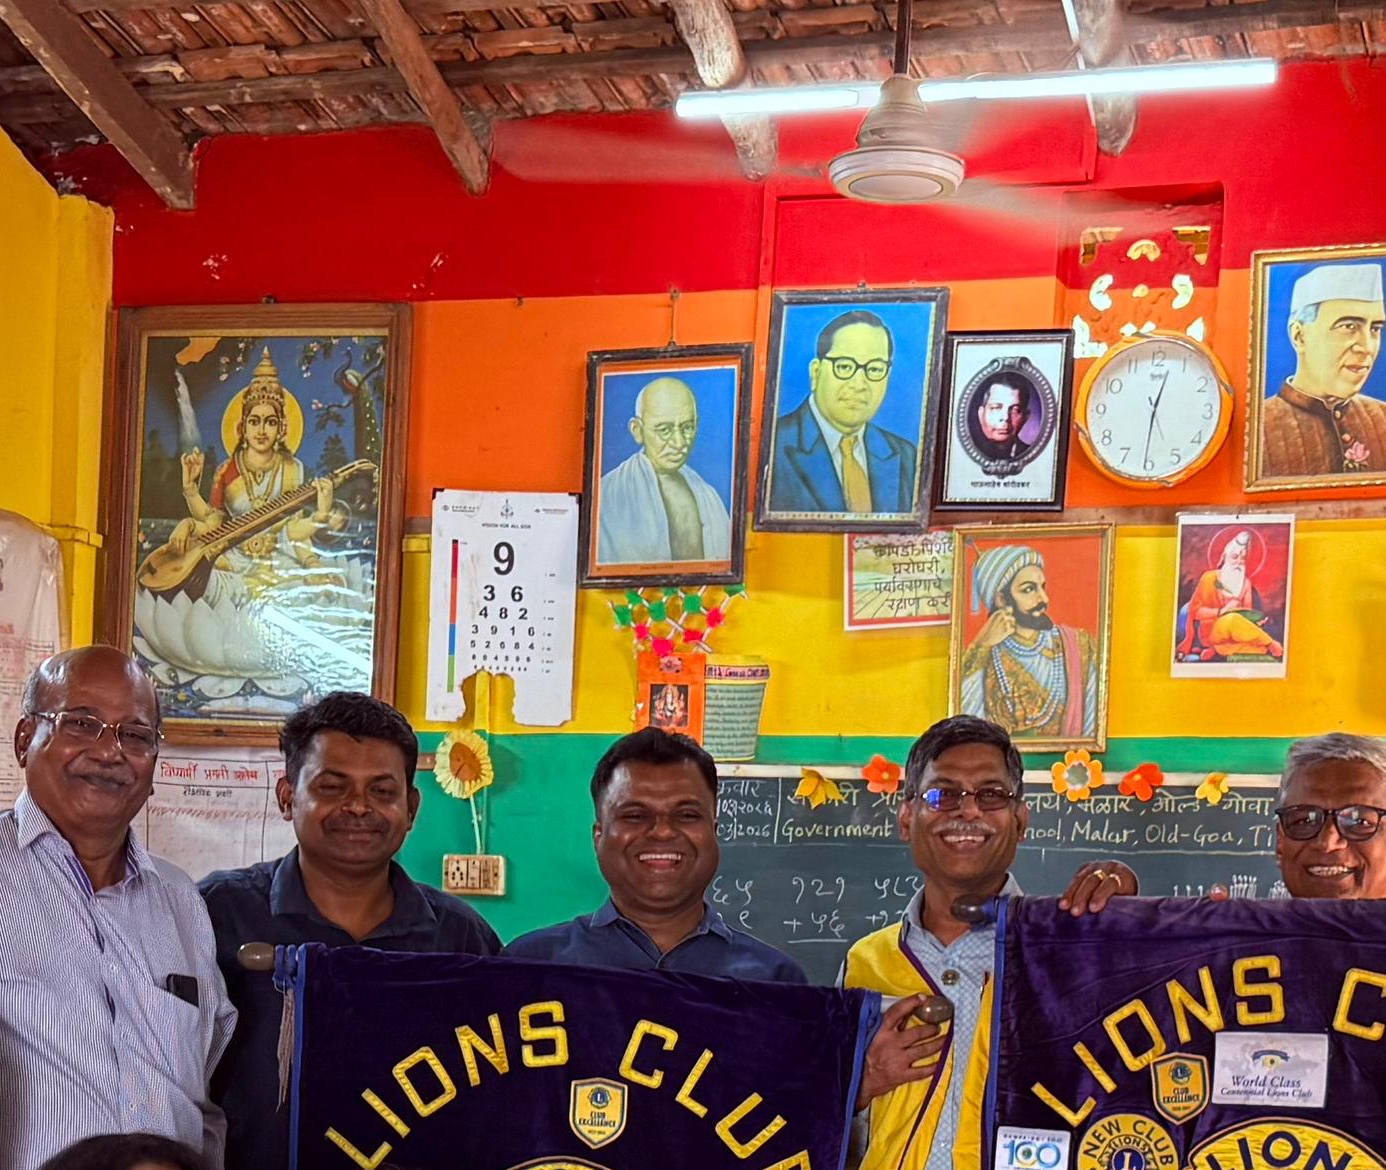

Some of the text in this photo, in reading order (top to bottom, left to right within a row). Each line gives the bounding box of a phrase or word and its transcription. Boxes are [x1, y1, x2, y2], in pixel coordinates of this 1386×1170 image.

[1151, 351, 1166, 367] 12
[1105, 378, 1123, 394] 10
[1196, 377, 1208, 393] 2
[1096, 404, 1107, 419] 9
[1202, 403, 1213, 420] 3
[1101, 429, 1112, 446] 8
[1190, 430, 1203, 444] 4
[1120, 447, 1131, 464] 7
[1170, 449, 1181, 465] 5
[493, 542, 514, 575] 9
[483, 585, 523, 602] 3 6
[479, 606, 528, 620] 4 8 2
[472, 625, 535, 636] 3 9 1 6
[782, 818, 894, 843] Government
[1031, 955, 1286, 1128] LIONS
[1232, 1075, 1302, 1088] World Class
[1220, 1087, 1313, 1099] Centennial Lions Club
[1084, 1119, 1174, 1165] NEW CLUB
[1114, 1136, 1148, 1151] LIONS
